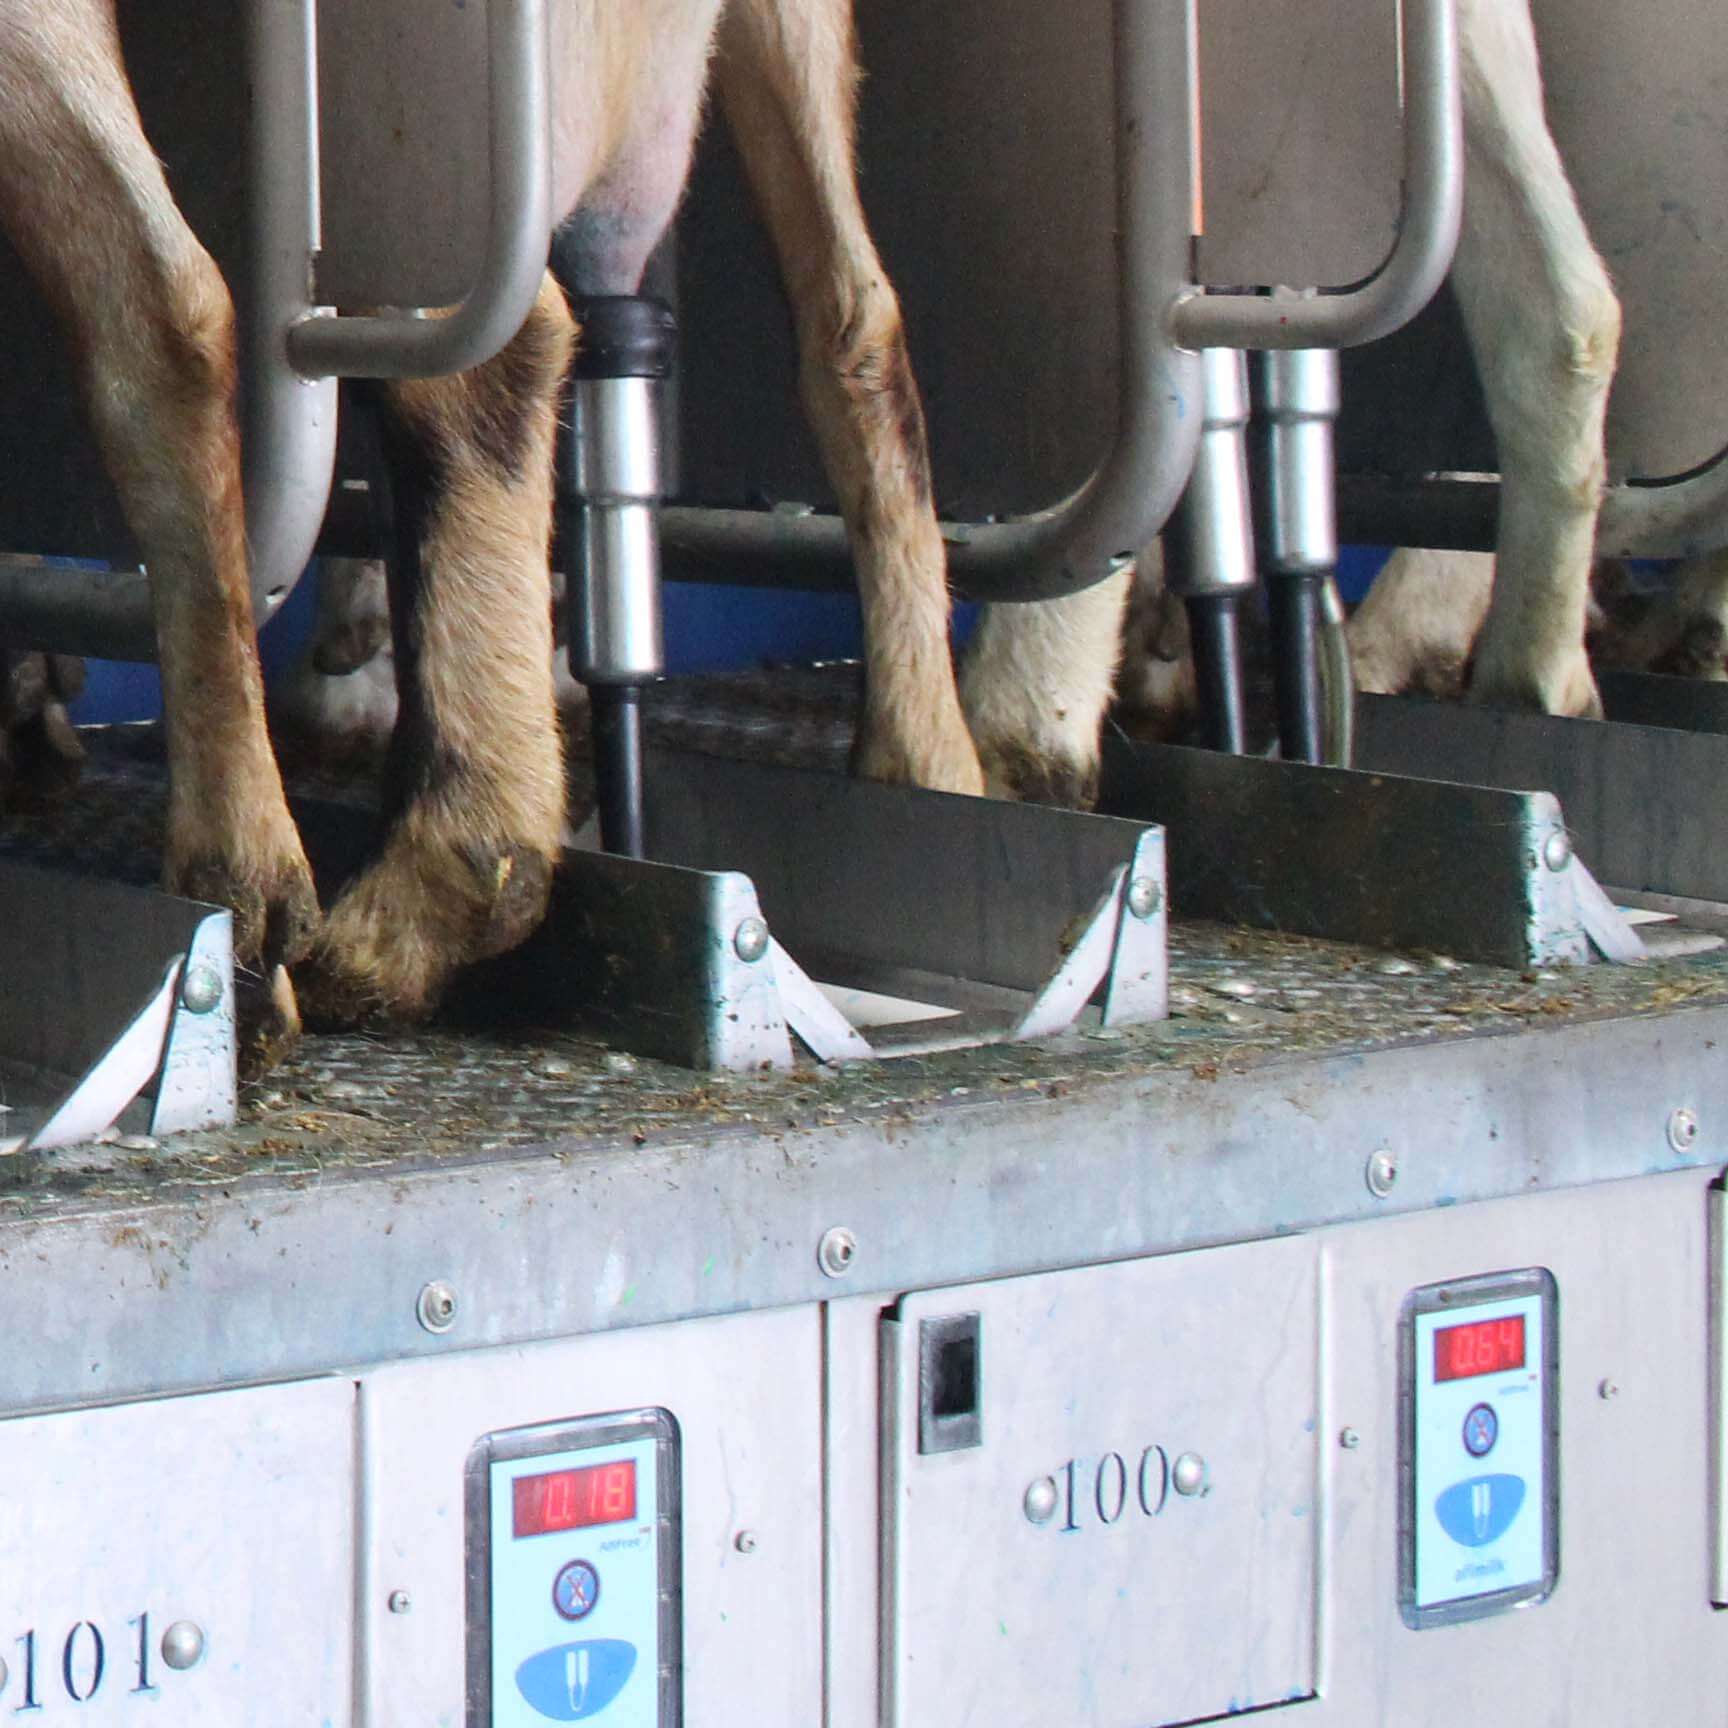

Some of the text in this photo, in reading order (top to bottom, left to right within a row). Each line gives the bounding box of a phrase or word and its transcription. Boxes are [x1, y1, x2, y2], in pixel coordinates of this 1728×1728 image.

[545, 1468, 629, 1522] 0.18
[1057, 1445, 1169, 1531] 100
[15, 1610, 156, 1711] 101
